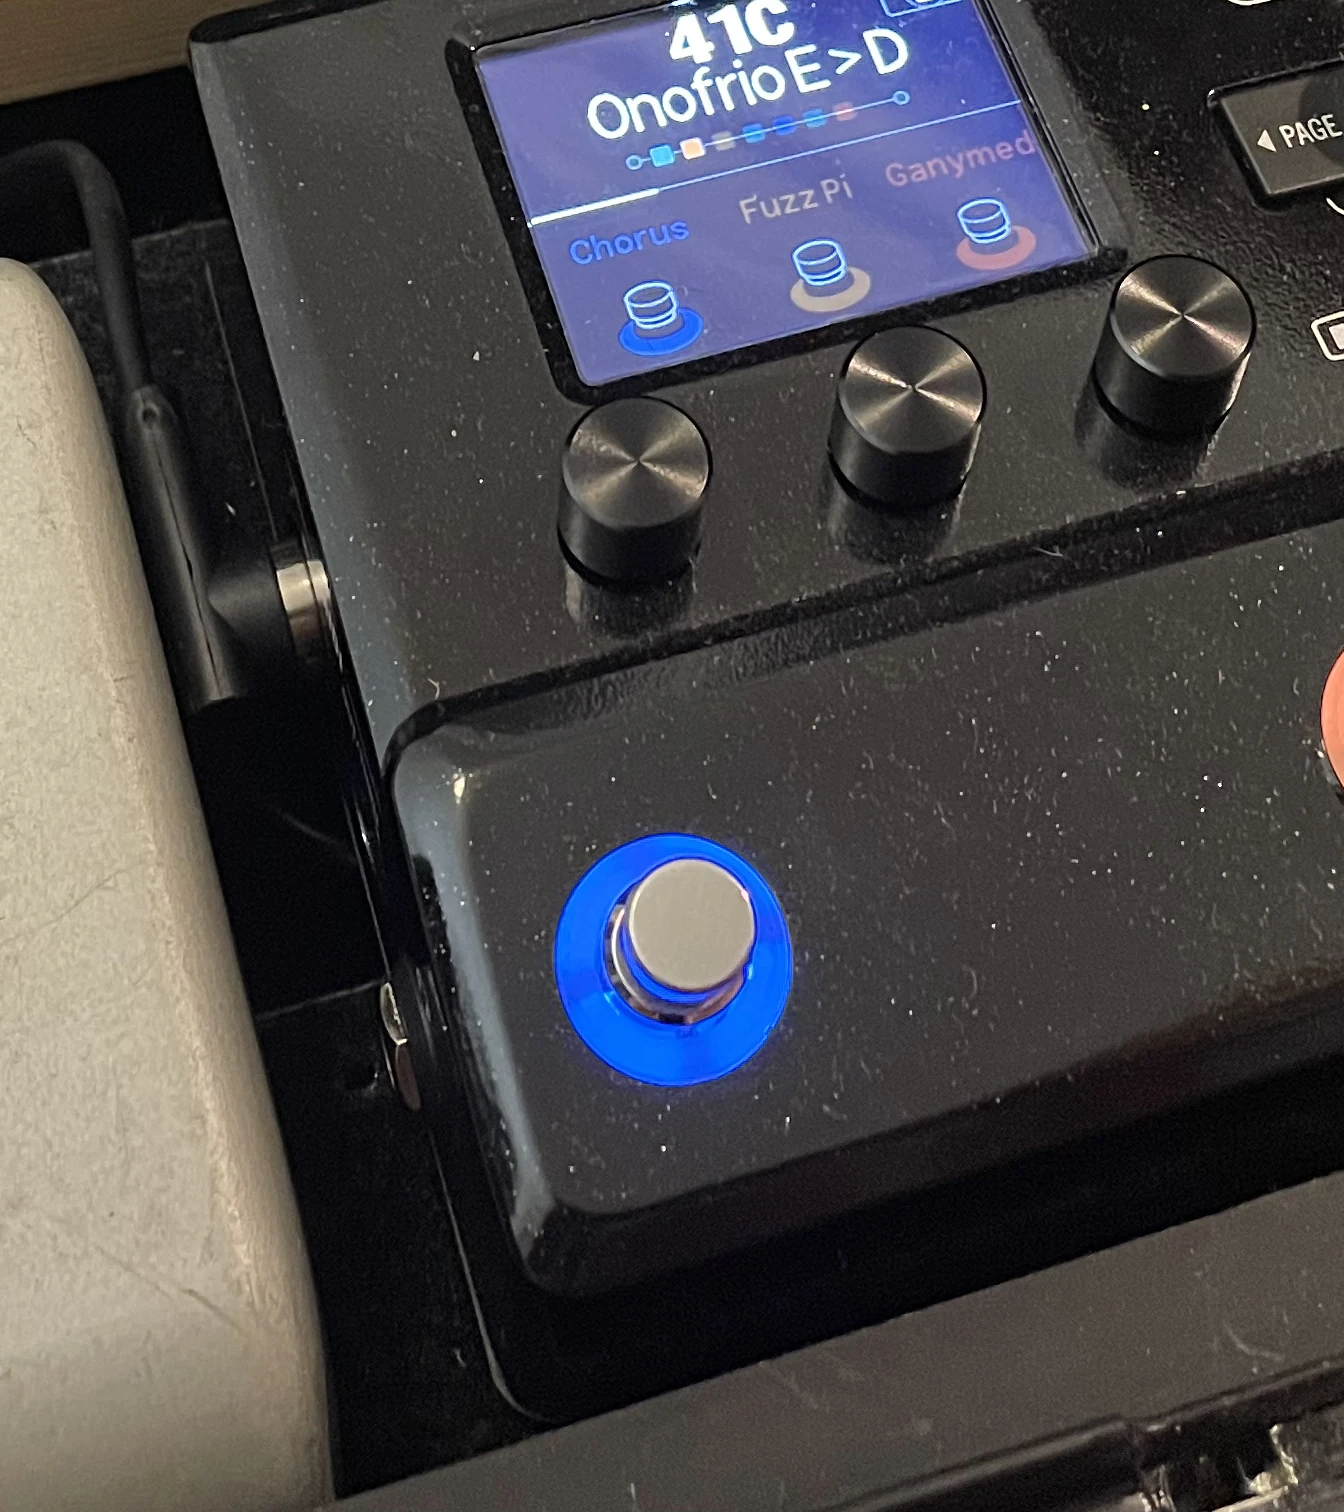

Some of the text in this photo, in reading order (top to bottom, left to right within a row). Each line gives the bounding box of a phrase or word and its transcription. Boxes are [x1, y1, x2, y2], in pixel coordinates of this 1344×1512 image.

[1278, 115, 1344, 148] PAGE
[884, 129, 1037, 188] Ganymed
[738, 172, 853, 225] Fuzz Pi
[568, 219, 691, 267] Chorus
